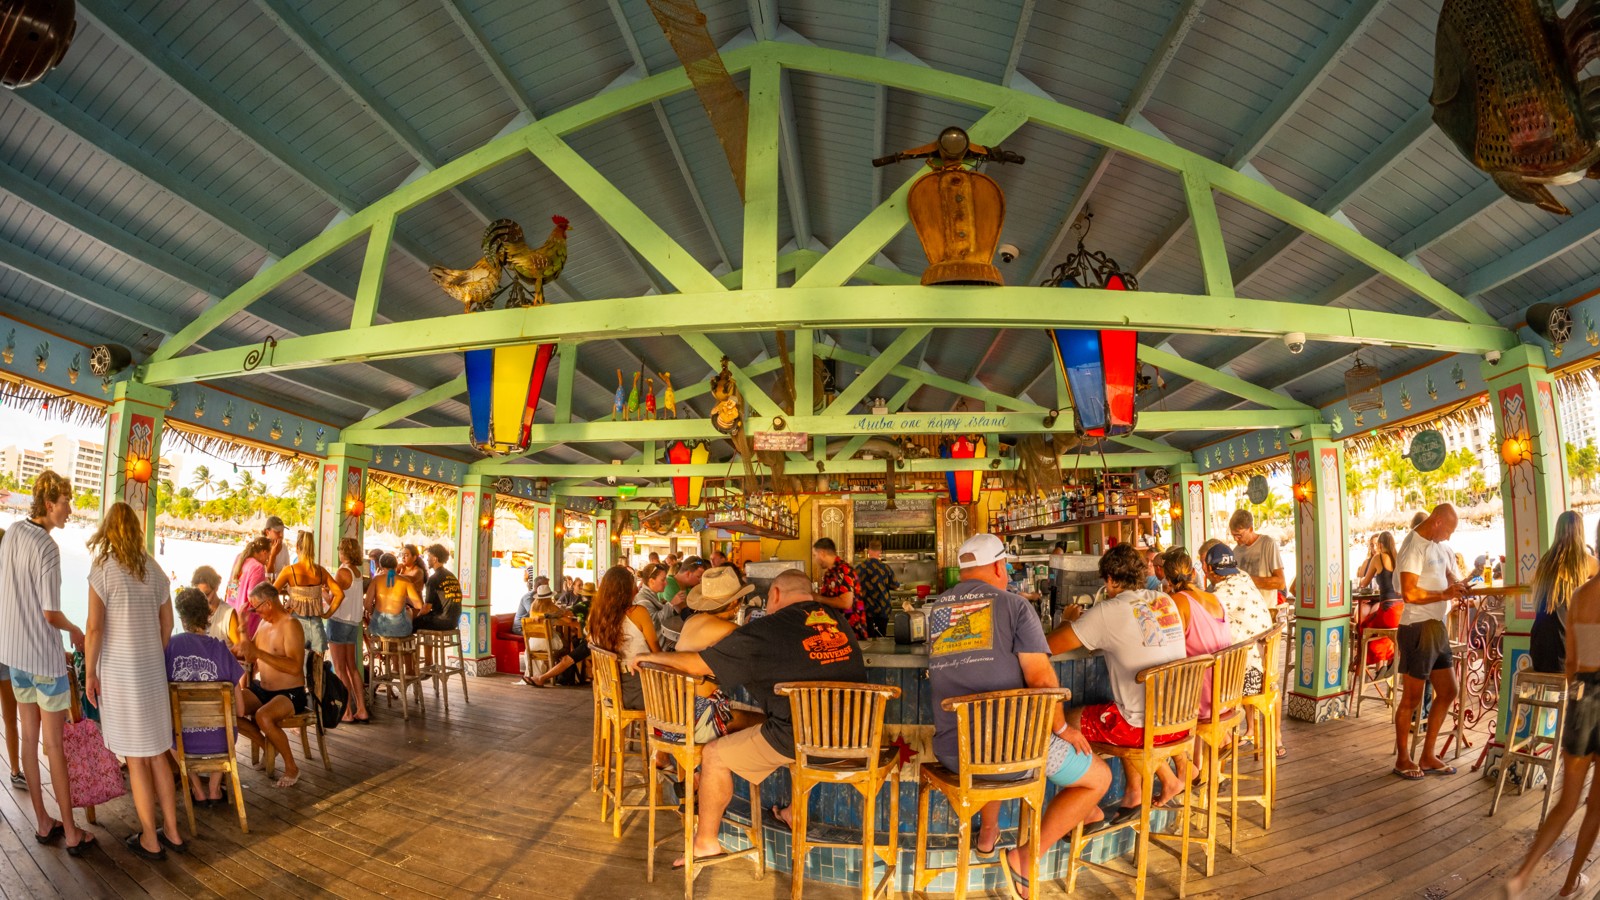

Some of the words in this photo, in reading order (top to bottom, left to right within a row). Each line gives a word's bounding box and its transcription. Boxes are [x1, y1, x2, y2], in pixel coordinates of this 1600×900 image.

[854, 417, 893, 430] Aruba
[901, 418, 920, 428] one
[928, 417, 961, 431] happy
[965, 416, 1009, 428] island
[940, 594, 956, 603] OVER
[959, 592, 985, 600] UNDER
[809, 645, 853, 659] CONVERSE
